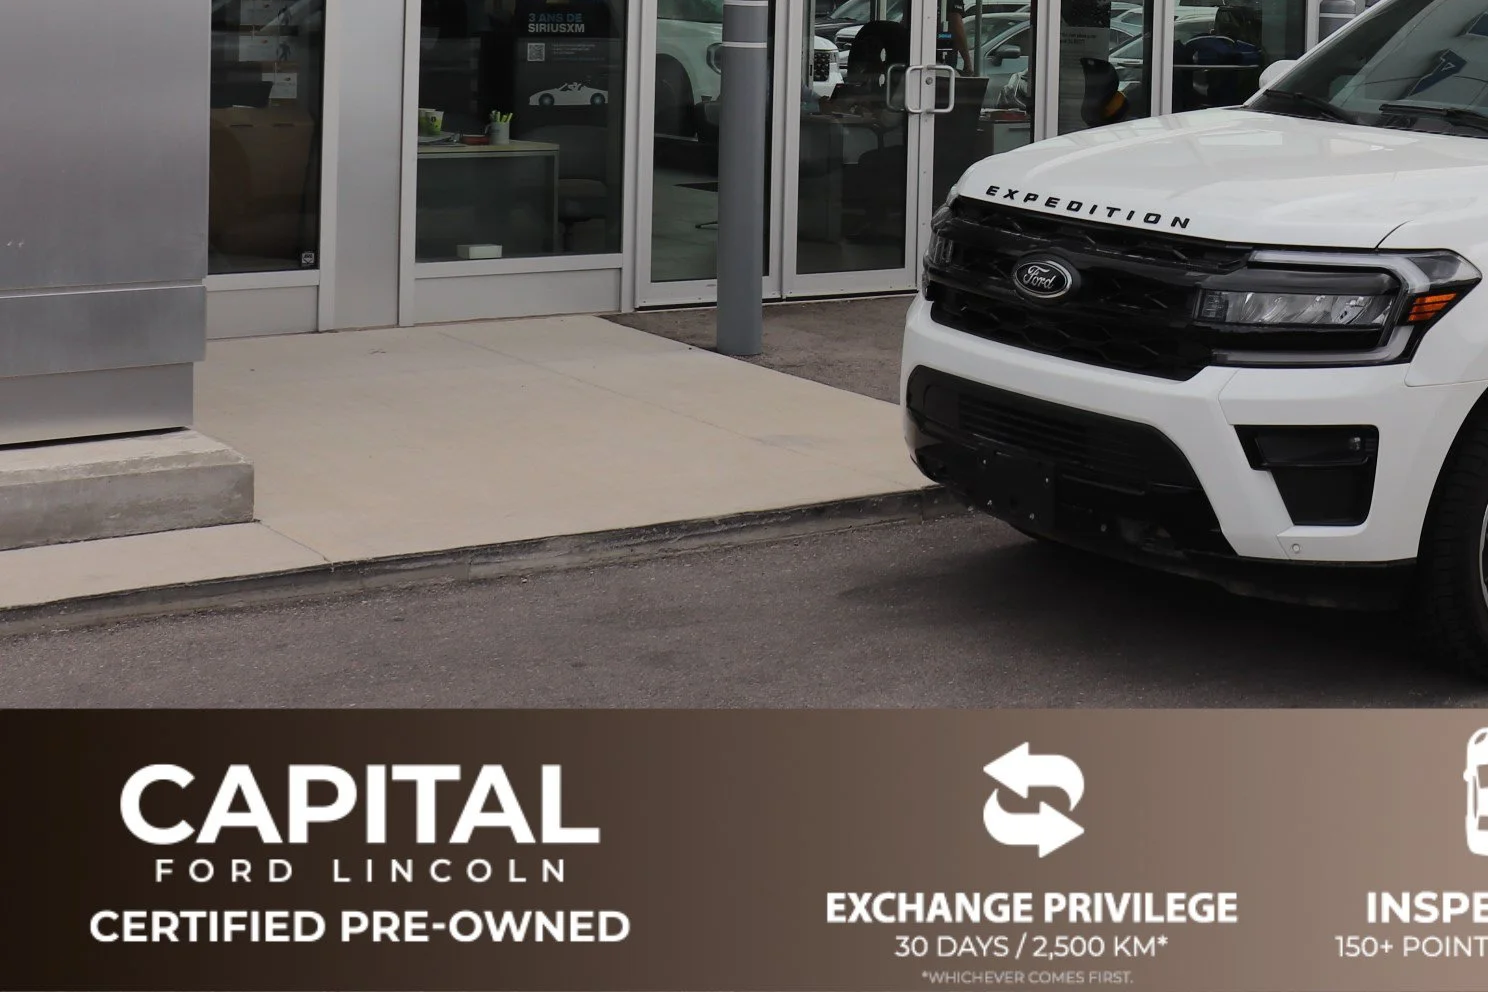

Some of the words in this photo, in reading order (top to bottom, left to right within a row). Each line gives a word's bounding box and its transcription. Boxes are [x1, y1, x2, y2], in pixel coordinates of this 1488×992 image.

[528, 12, 536, 23] 3
[538, 12, 564, 23] ANS
[566, 13, 583, 23] DE
[527, 23, 585, 33] SIRIUSXM
[985, 185, 1191, 229] EXPEDITION
